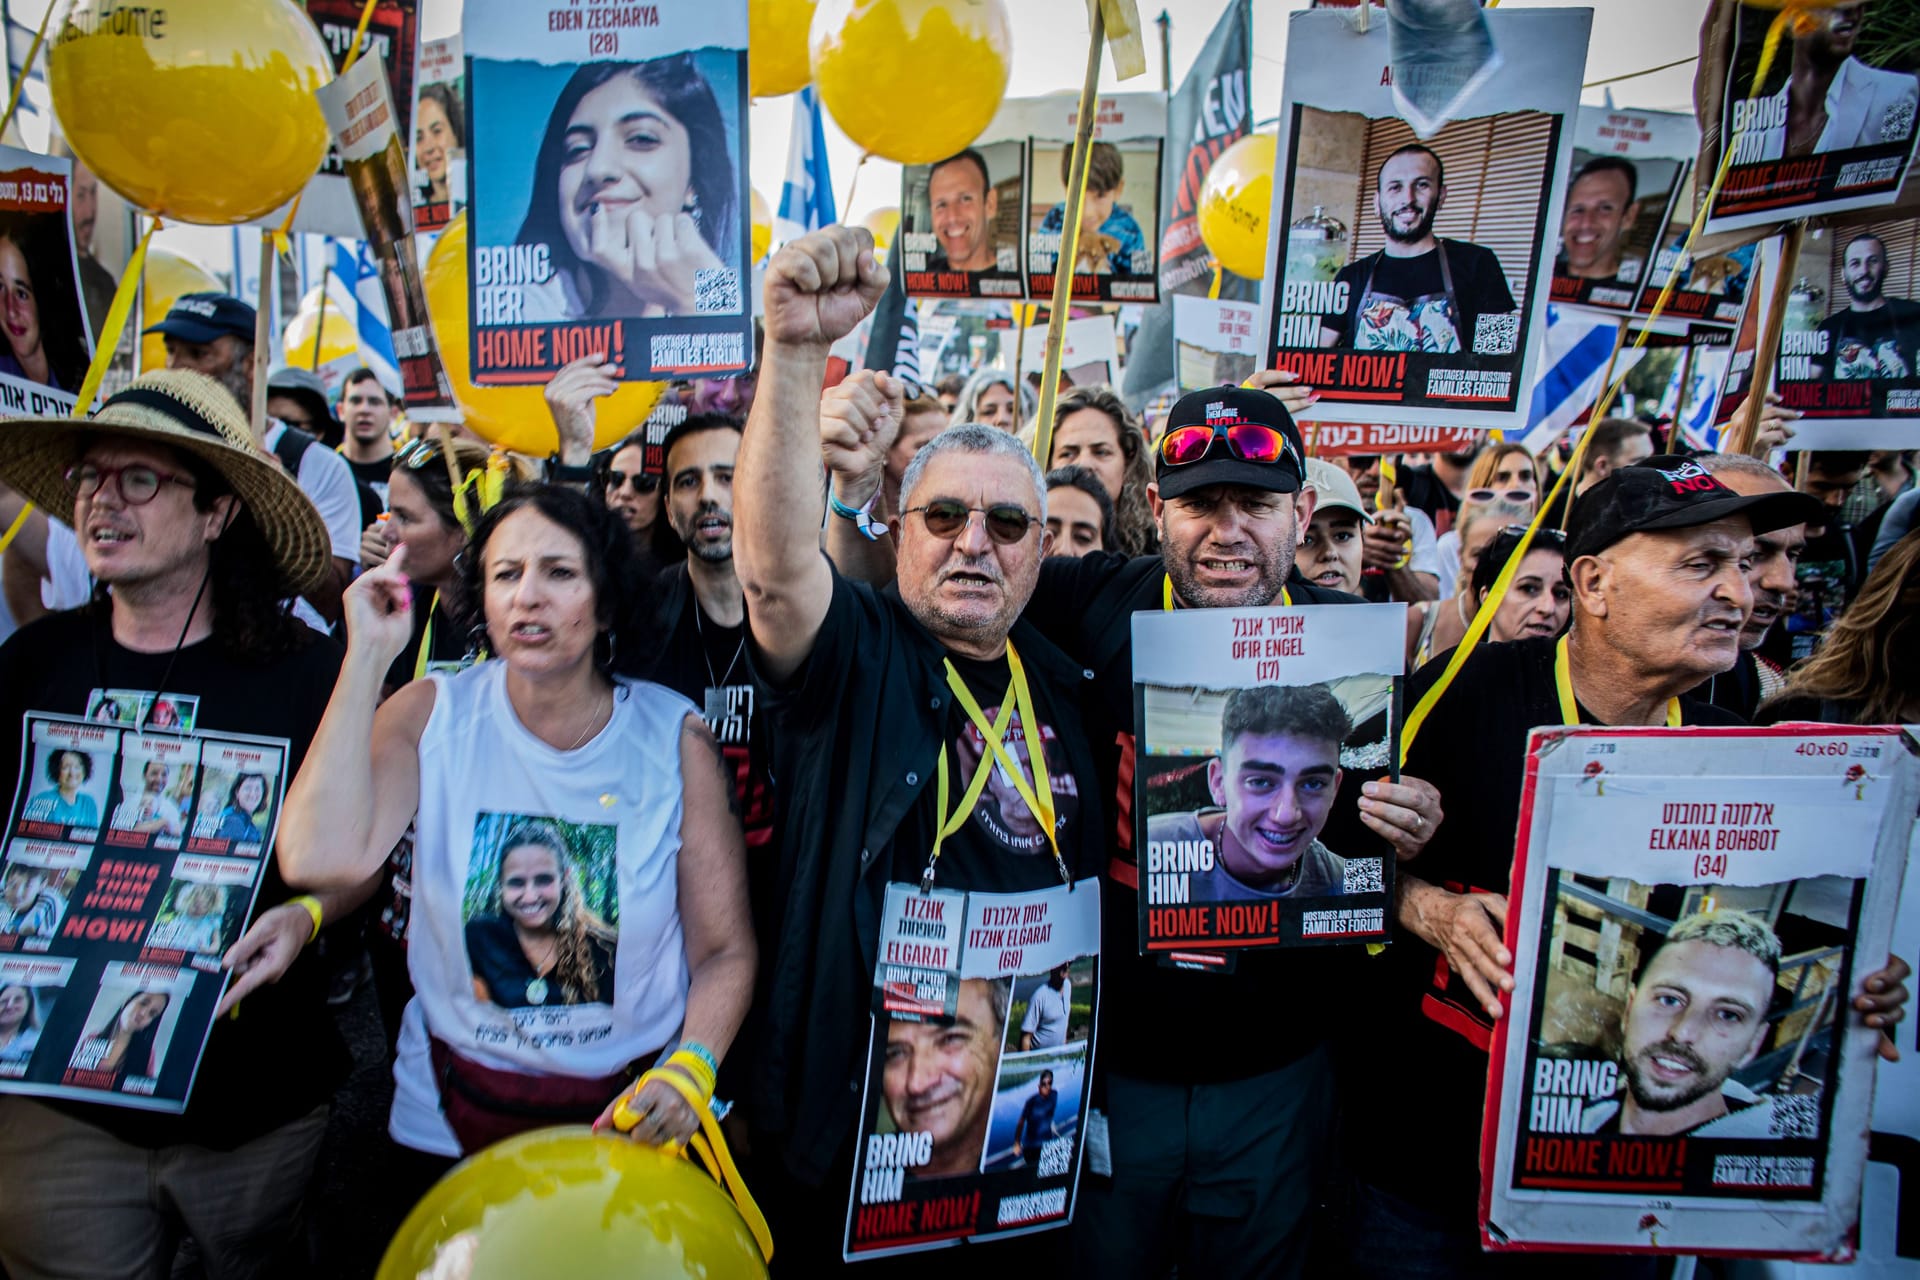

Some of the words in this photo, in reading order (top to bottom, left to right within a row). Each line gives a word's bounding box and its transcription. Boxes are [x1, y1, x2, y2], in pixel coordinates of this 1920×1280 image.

[549, 10, 582, 32] EDEN
[587, 6, 660, 30] ZECHARYA
[590, 32, 619, 56] (28)
[1732, 95, 1789, 134] BRING
[1729, 130, 1768, 167] HIM
[1722, 164, 1775, 203] HOME
[1772, 154, 1829, 193] NOW!
[1029, 233, 1061, 253] BRIN
[475, 243, 550, 287] BRING
[906, 272, 937, 290] HOME
[938, 271, 970, 292] NOW!
[1072, 272, 1100, 293] OW!
[476, 287, 523, 326] HER
[1281, 280, 1350, 315] BRING
[1277, 314, 1322, 348] HIM
[1782, 330, 1830, 356] BRING
[477, 328, 547, 369] HOME
[552, 319, 625, 365] NOW!
[651, 347, 701, 368] FAMILIES
[702, 345, 745, 366] FORUM
[1276, 352, 1338, 385] HOME
[1341, 352, 1407, 389] NOW!
[1428, 368, 1465, 382] HOSTAGES
[1464, 370, 1480, 382] AND
[1480, 371, 1512, 384] MISSING
[1779, 355, 1811, 381] HIM
[1426, 380, 1473, 397] FAMILIES
[1472, 381, 1509, 398] FORUM
[1779, 383, 1824, 408] HOME
[1826, 380, 1873, 408] NOW!
[1369, 424, 1440, 445] חטופה
[1232, 617, 1264, 638] אנגל
[1267, 615, 1305, 636] אופיר
[1232, 640, 1261, 660] OFIR
[1265, 637, 1306, 658] ENGEL
[1256, 659, 1280, 682] (17)
[1795, 742, 1848, 757] 40x60
[1662, 803, 1717, 825] בוחבוט
[1721, 802, 1775, 827] אלקנה
[1649, 829, 1711, 850] ELKANA
[1714, 829, 1780, 851] BOHBOT
[1147, 839, 1215, 873] BRING
[1694, 853, 1727, 879] (34)
[98, 858, 161, 882] BRING
[95, 877, 153, 898] THEM
[1147, 872, 1190, 905] HIM
[82, 891, 146, 913] HOME
[904, 898, 945, 922] ITZHK
[1022, 902, 1048, 926] יצחק
[1302, 911, 1338, 922] HOSTAGES
[1338, 909, 1353, 920] AND
[1352, 907, 1384, 919] MISSING
[61, 914, 148, 943] NOW!
[898, 917, 947, 940] משפחות
[983, 905, 1022, 928] אלגרט
[1148, 907, 1210, 938] HOME
[1215, 900, 1279, 935] NOW!
[1302, 919, 1347, 935] FAMILIES
[1347, 917, 1384, 932] FORUM
[969, 927, 1006, 949] ITZHK
[1006, 922, 1053, 946] ELGARAT
[886, 941, 949, 968] ELGARAT
[998, 949, 1024, 973] (68)
[1533, 1057, 1618, 1098] BRING
[1529, 1095, 1584, 1134] HIM
[866, 1130, 934, 1170] BRING
[1525, 1137, 1603, 1175] HOME
[1608, 1138, 1688, 1178] NOW!
[861, 1167, 905, 1206] HIM
[1711, 1166, 1769, 1186] FAMILIES
[856, 1202, 919, 1241] HOME
[920, 1189, 983, 1233] NOW!
